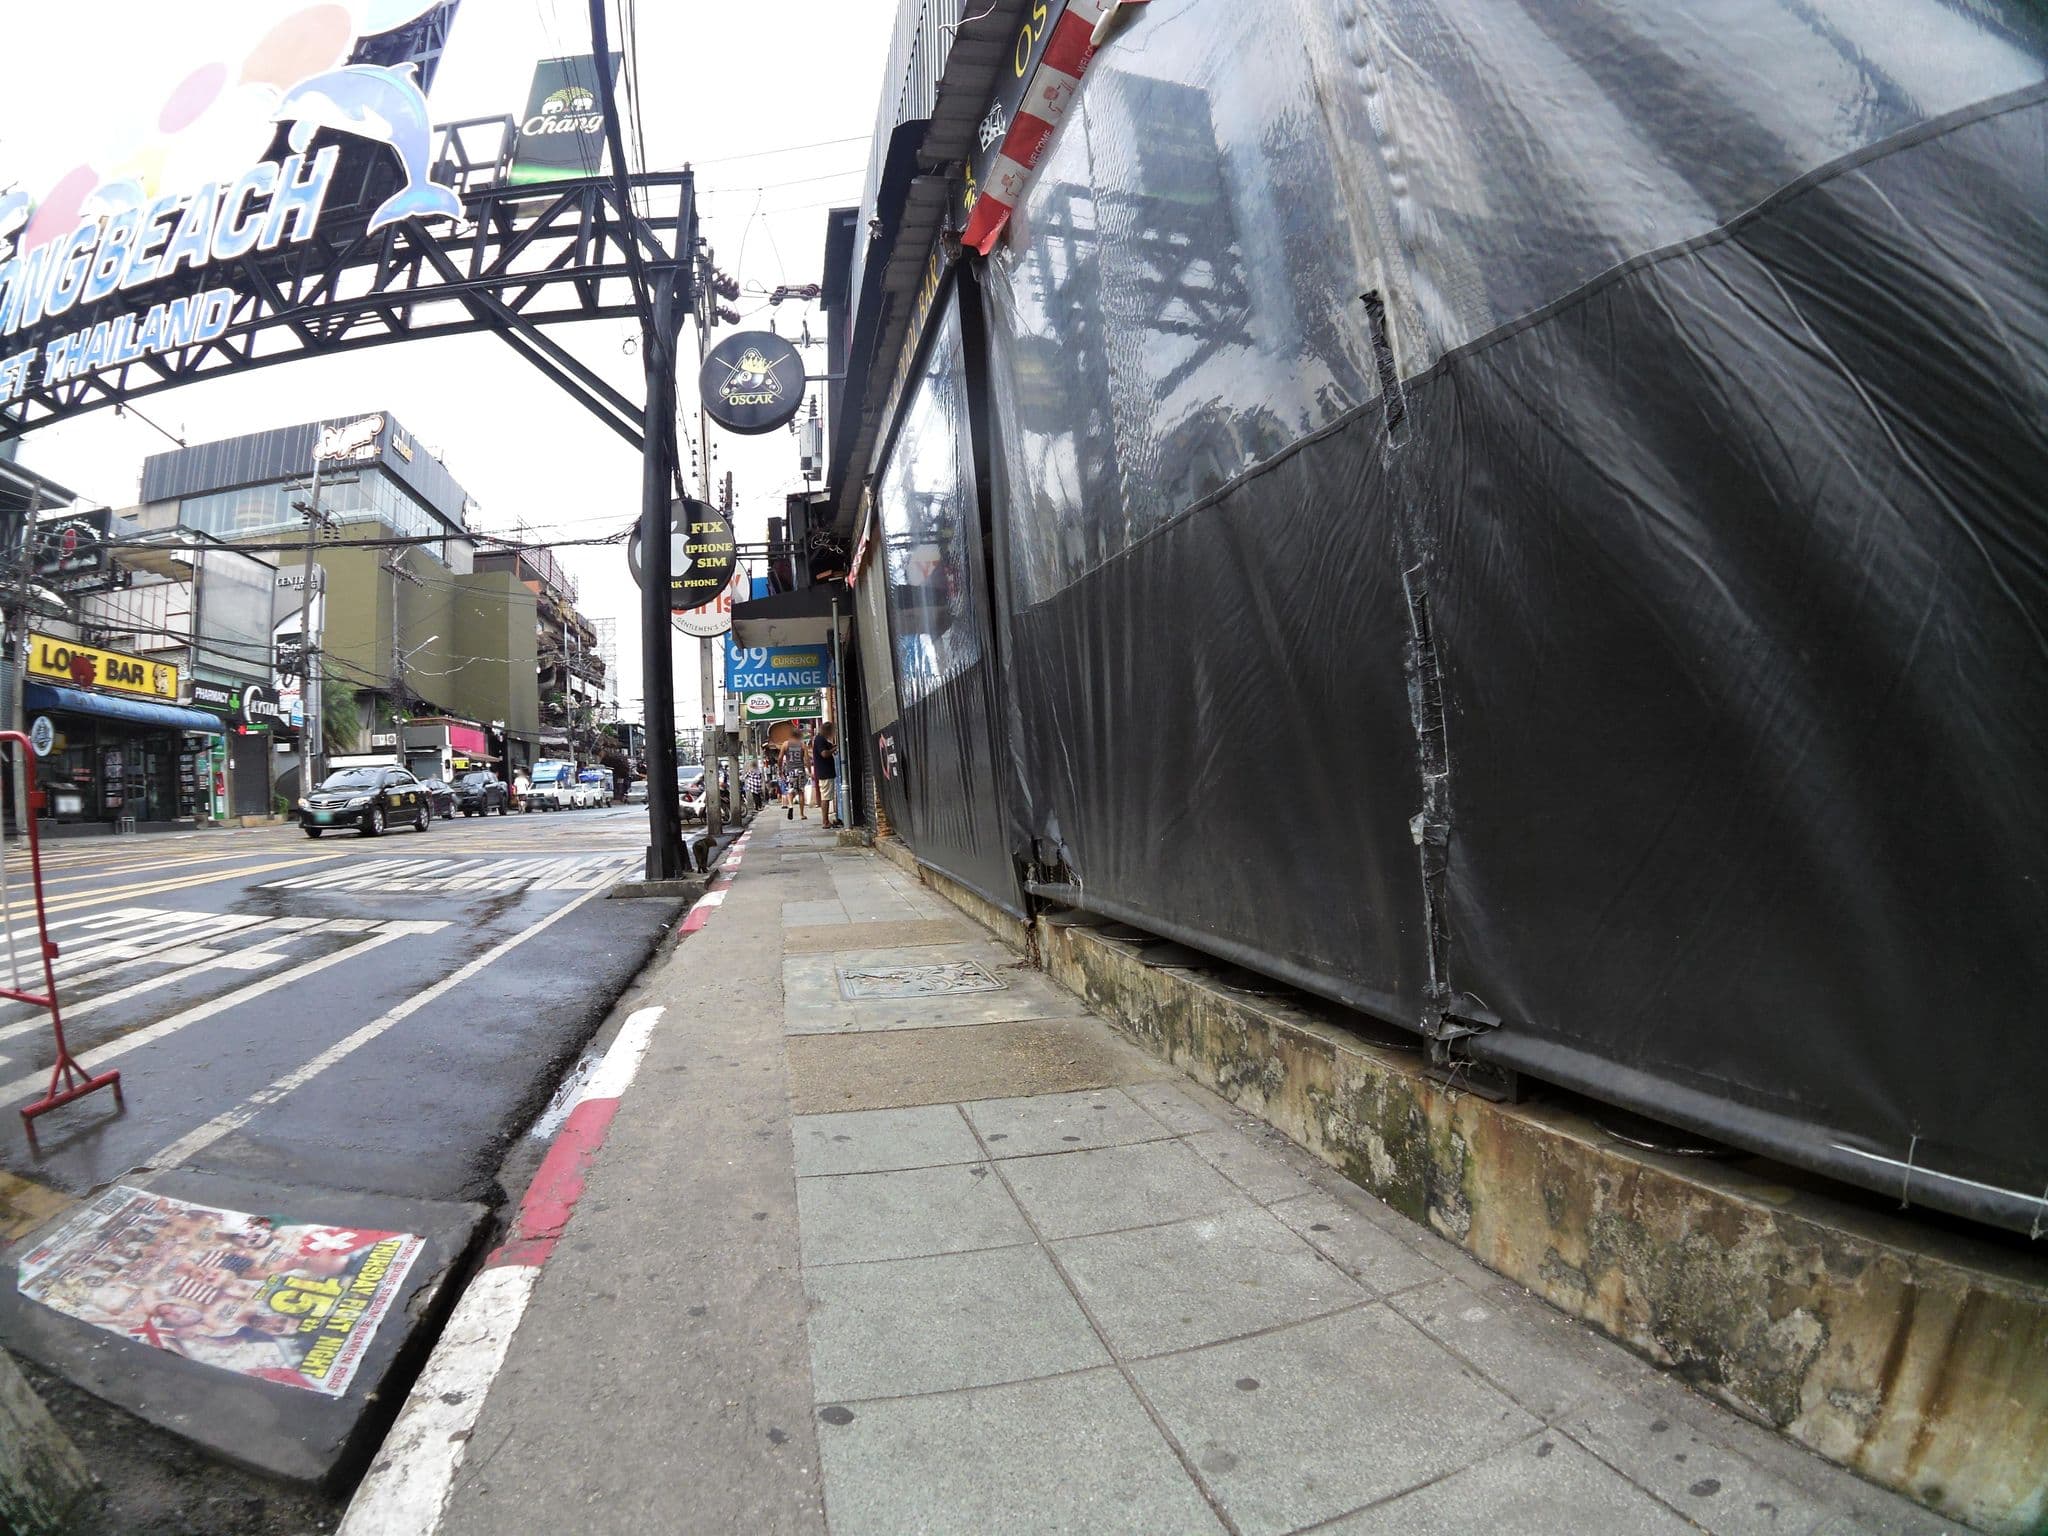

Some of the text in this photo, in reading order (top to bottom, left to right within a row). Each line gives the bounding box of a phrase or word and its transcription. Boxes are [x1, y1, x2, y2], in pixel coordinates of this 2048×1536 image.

[1077, 44, 1094, 74] WELCO
[522, 115, 605, 136] Chang
[1028, 129, 1052, 167] WELCOME
[43, 287, 235, 387] THAILAND
[729, 394, 774, 406] OSCAR
[691, 522, 724, 534] FIX
[685, 542, 733, 554] IPHONE
[697, 557, 727, 568] SIM
[276, 572, 317, 587] CENTRL
[684, 579, 718, 588] PHONE
[730, 646, 817, 670] 99 CURRENCY
[106, 658, 144, 685] BAR
[734, 671, 822, 688] EXCHANGE
[194, 687, 229, 703] PHARMACY
[299, 1240, 402, 1379] THURSDAY FIGHT NIGHT
[368, 1288, 392, 1317] STADIUM
[327, 1367, 348, 1389] ROAD
